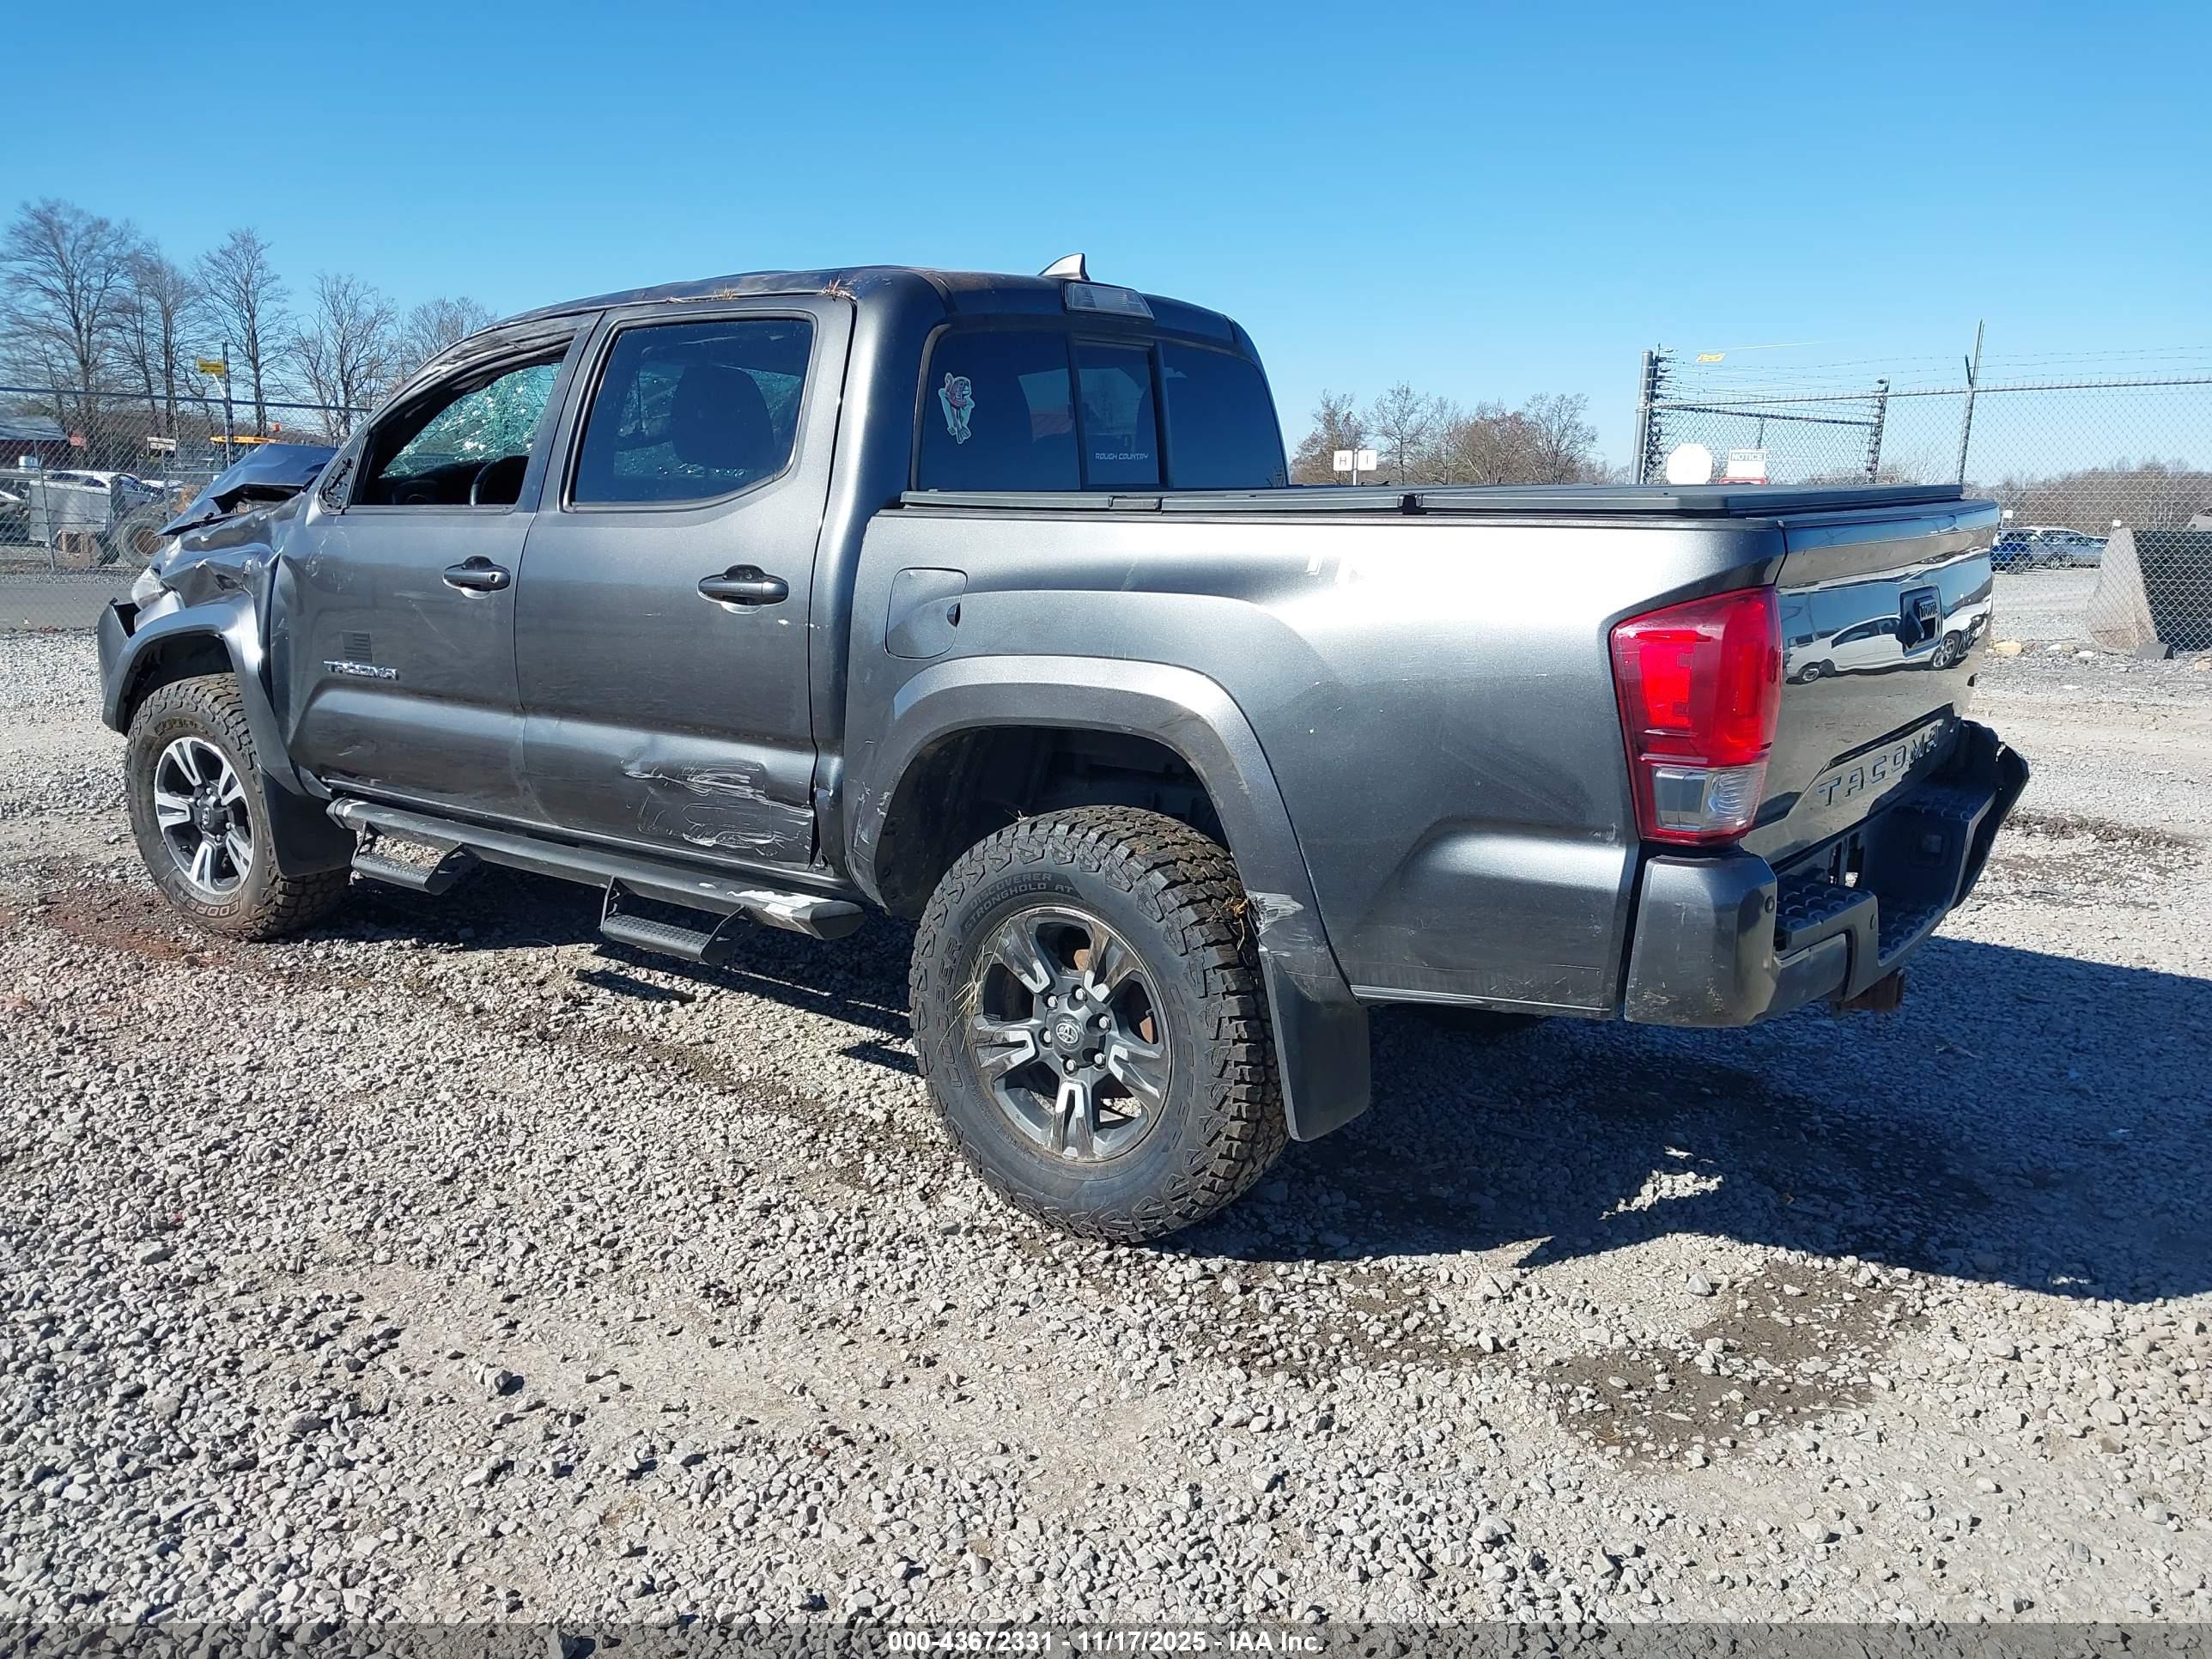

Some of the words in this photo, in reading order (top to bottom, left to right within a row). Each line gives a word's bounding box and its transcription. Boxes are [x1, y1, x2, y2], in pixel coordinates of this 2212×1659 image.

[1817, 723, 1939, 806] TACOMA
[964, 882, 1047, 930] STRONGHOLD
[1054, 884, 1073, 893] AT
[970, 872, 1052, 908] DISCOVERER
